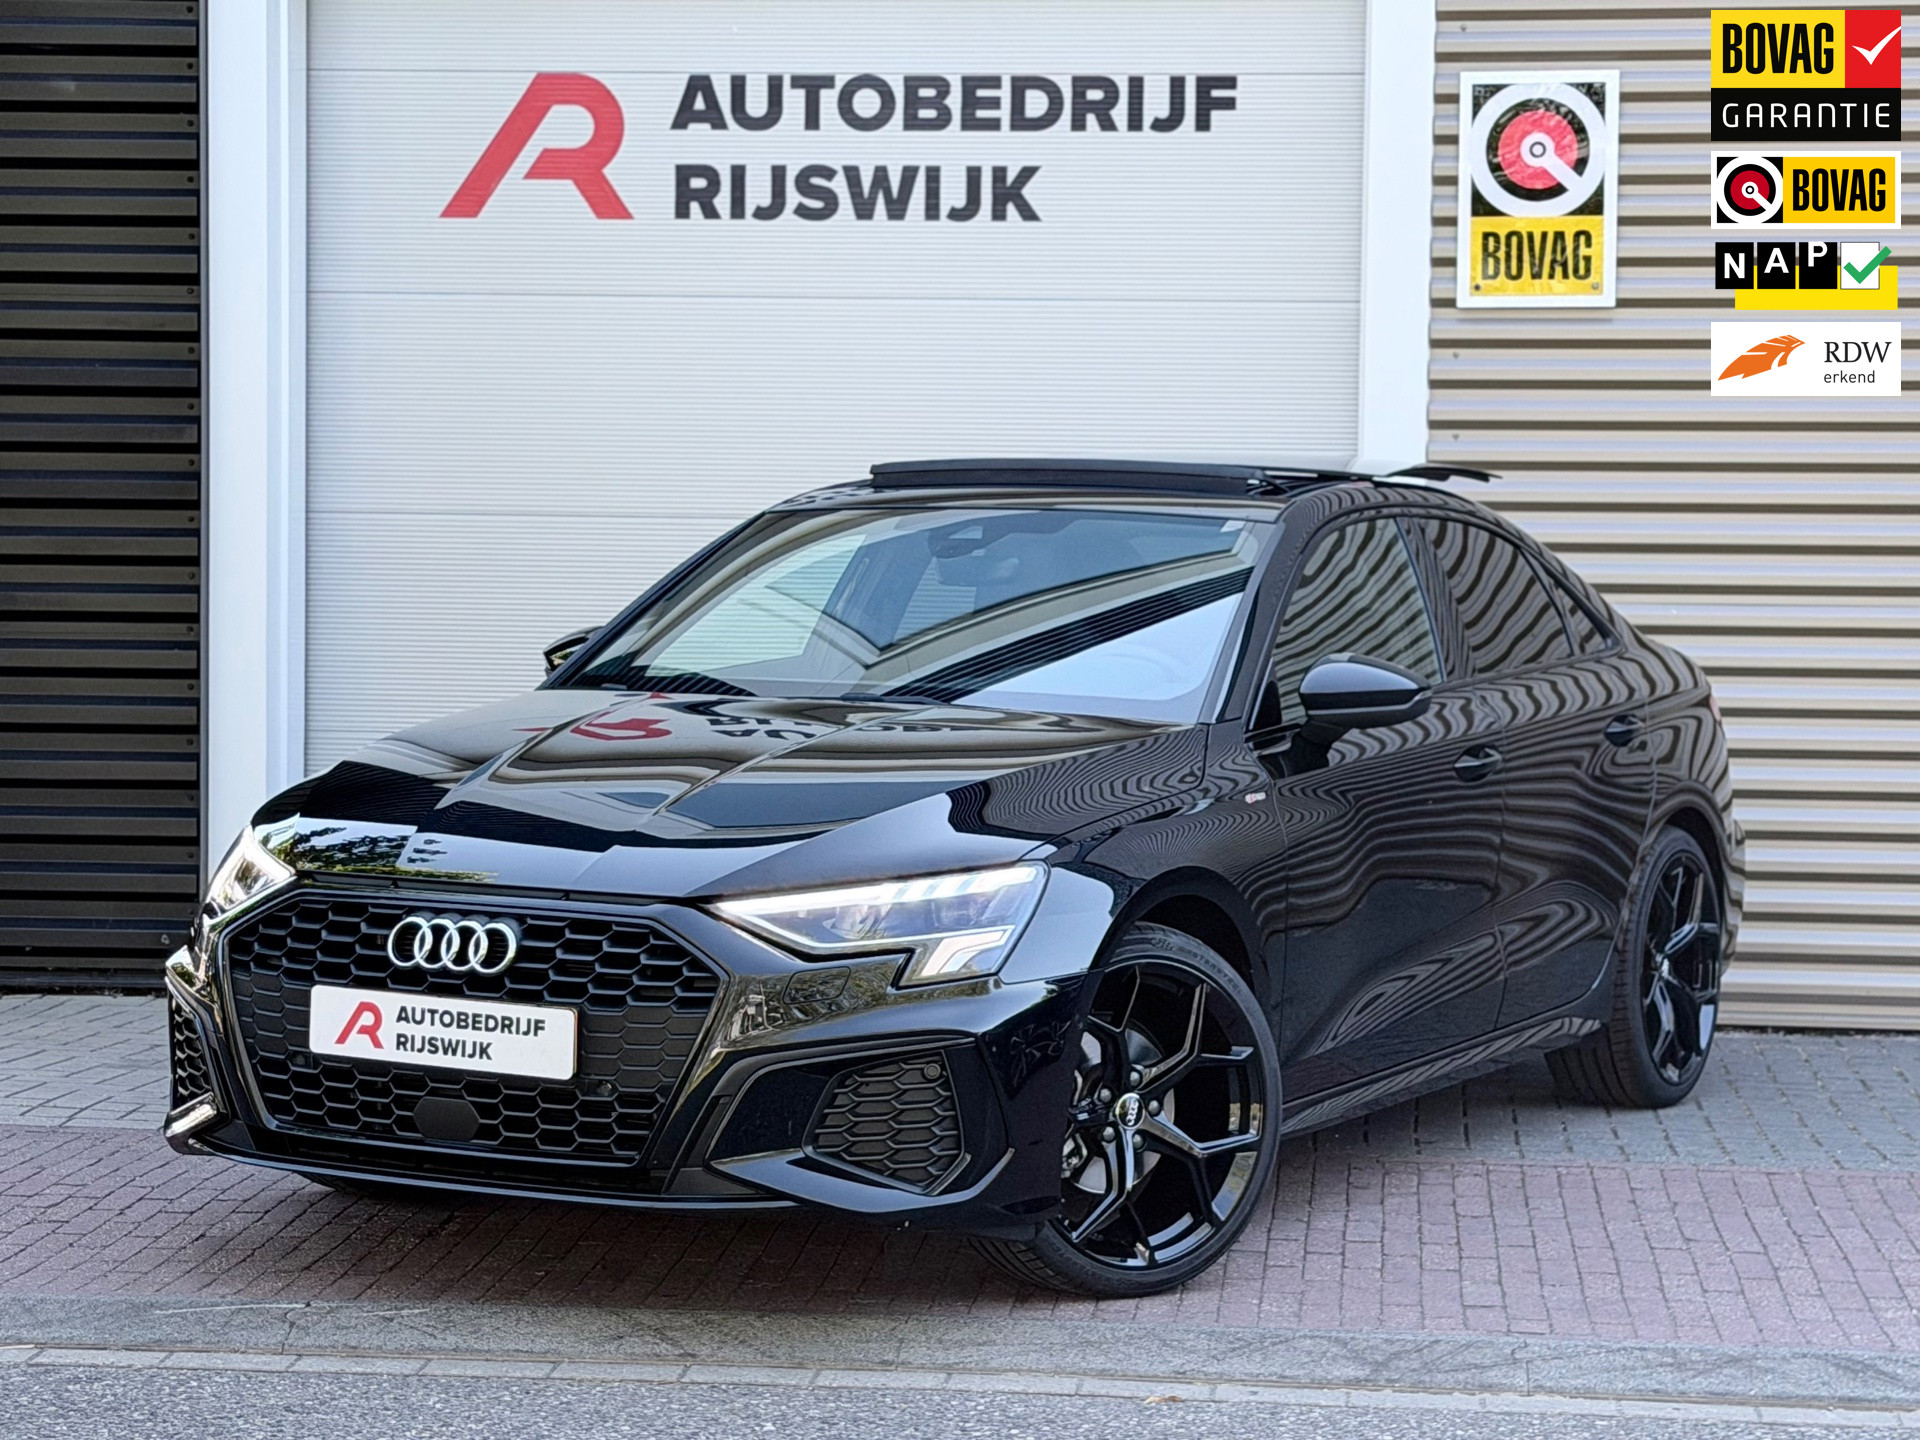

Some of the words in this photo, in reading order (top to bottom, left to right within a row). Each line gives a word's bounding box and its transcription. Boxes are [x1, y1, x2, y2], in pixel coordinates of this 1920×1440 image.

[670, 73, 1238, 133] AUTOBEDRIJF
[674, 163, 1042, 223] RIJSWIJK
[1481, 230, 1593, 281] BOVAG
[396, 1005, 545, 1037] AUTOBEDRIJF
[396, 1034, 493, 1060] RIJSWIJK
